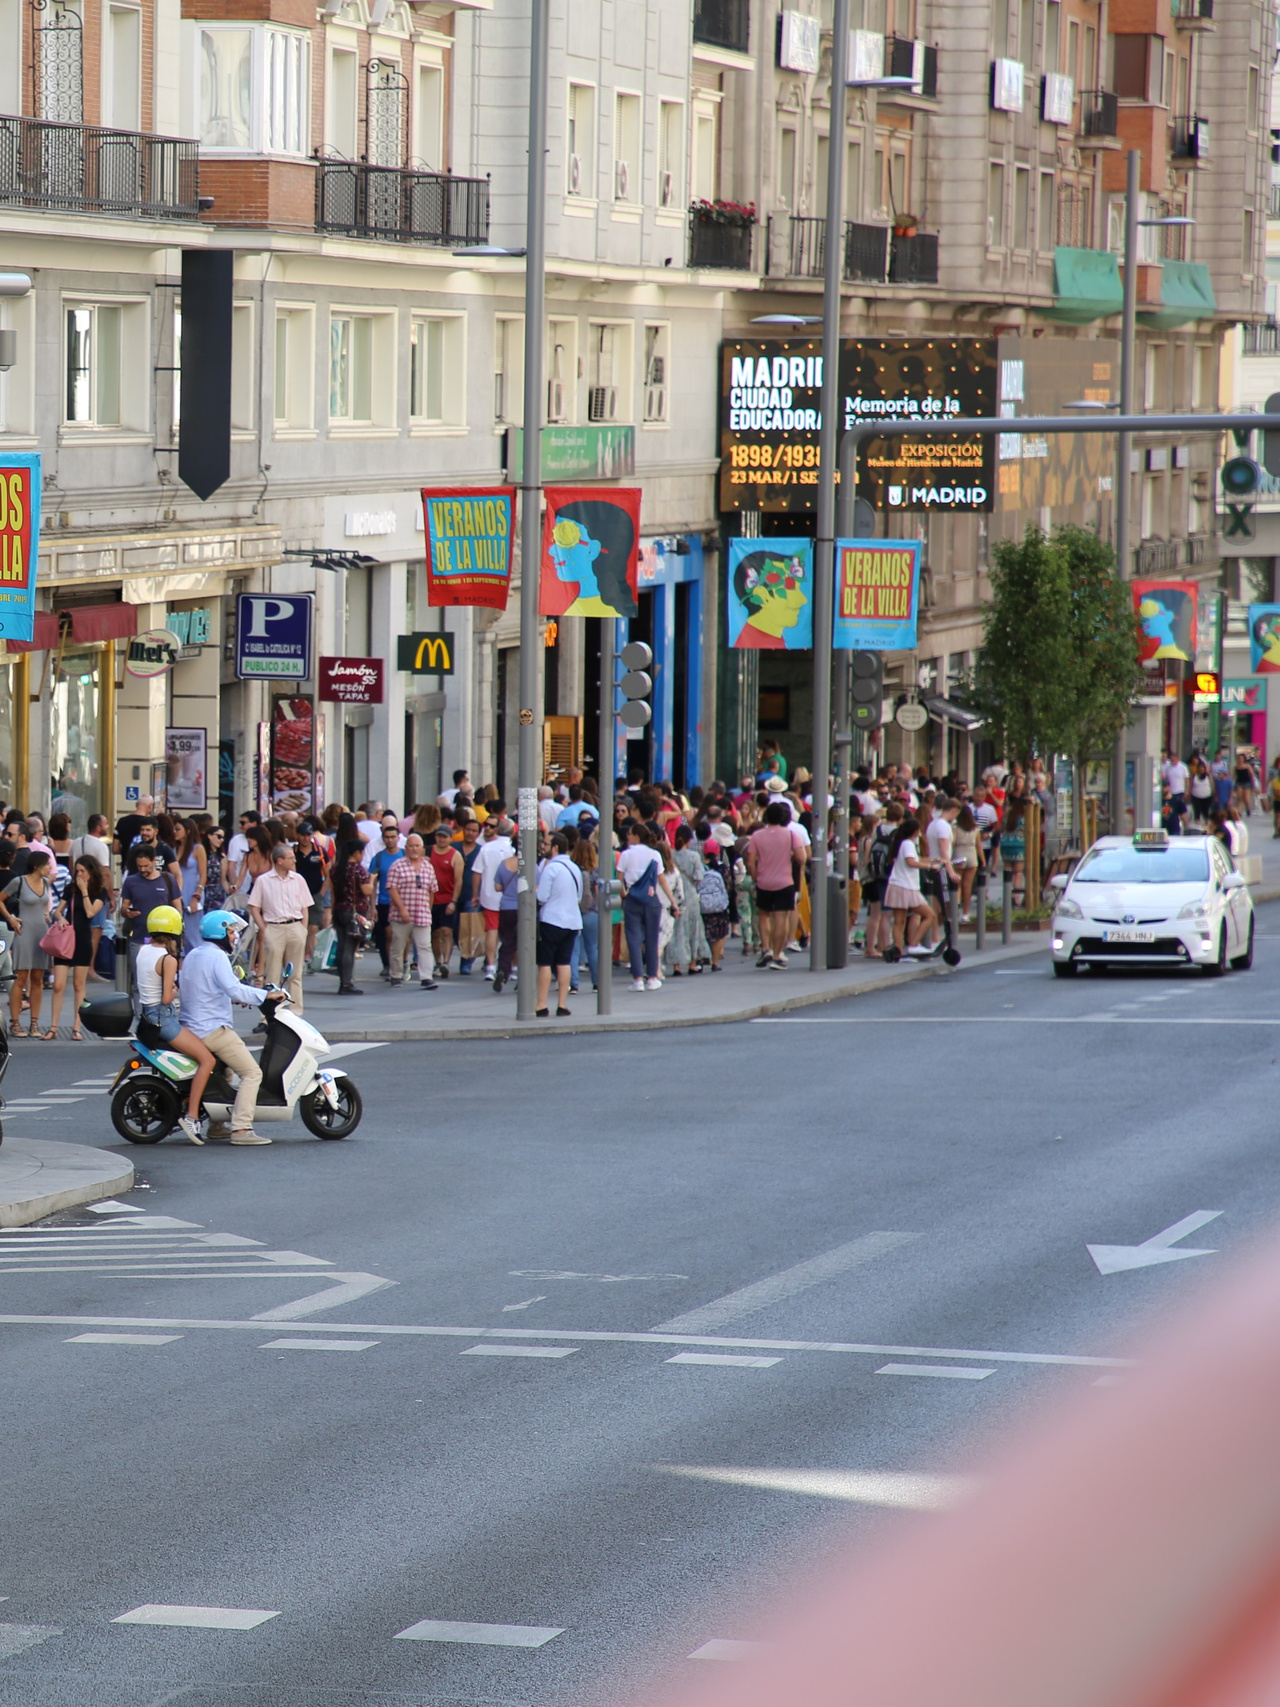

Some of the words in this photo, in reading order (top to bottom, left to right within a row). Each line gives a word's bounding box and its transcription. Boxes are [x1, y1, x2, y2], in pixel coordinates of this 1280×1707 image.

[730, 387, 792, 409] CIUDAD
[845, 397, 918, 413] Memoria
[921, 396, 942, 413] de
[944, 396, 960, 413] la
[900, 442, 983, 457] EXPOSICIÓN
[867, 458, 894, 467] Museo
[907, 458, 940, 467] Historia
[953, 458, 983, 467] Madrid
[730, 471, 747, 484] 23
[912, 487, 987, 504] MADRID
[432, 499, 507, 538] VERANOS
[435, 540, 452, 571] DE
[455, 540, 472, 569] LA
[474, 540, 506, 571] VILLA
[845, 551, 911, 587] VERANOS
[14, 595, 27, 603] 2019
[843, 587, 858, 615] DE
[861, 588, 874, 615] LA
[878, 588, 908, 616] VILLA
[246, 598, 295, 637] P
[128, 642, 176, 664] Mel's
[245, 660, 279, 672] PUBLICO
[281, 661, 290, 672] 24
[328, 660, 378, 677] Jamón
[331, 682, 365, 691] MESÓN
[338, 693, 370, 701] TAPAS
